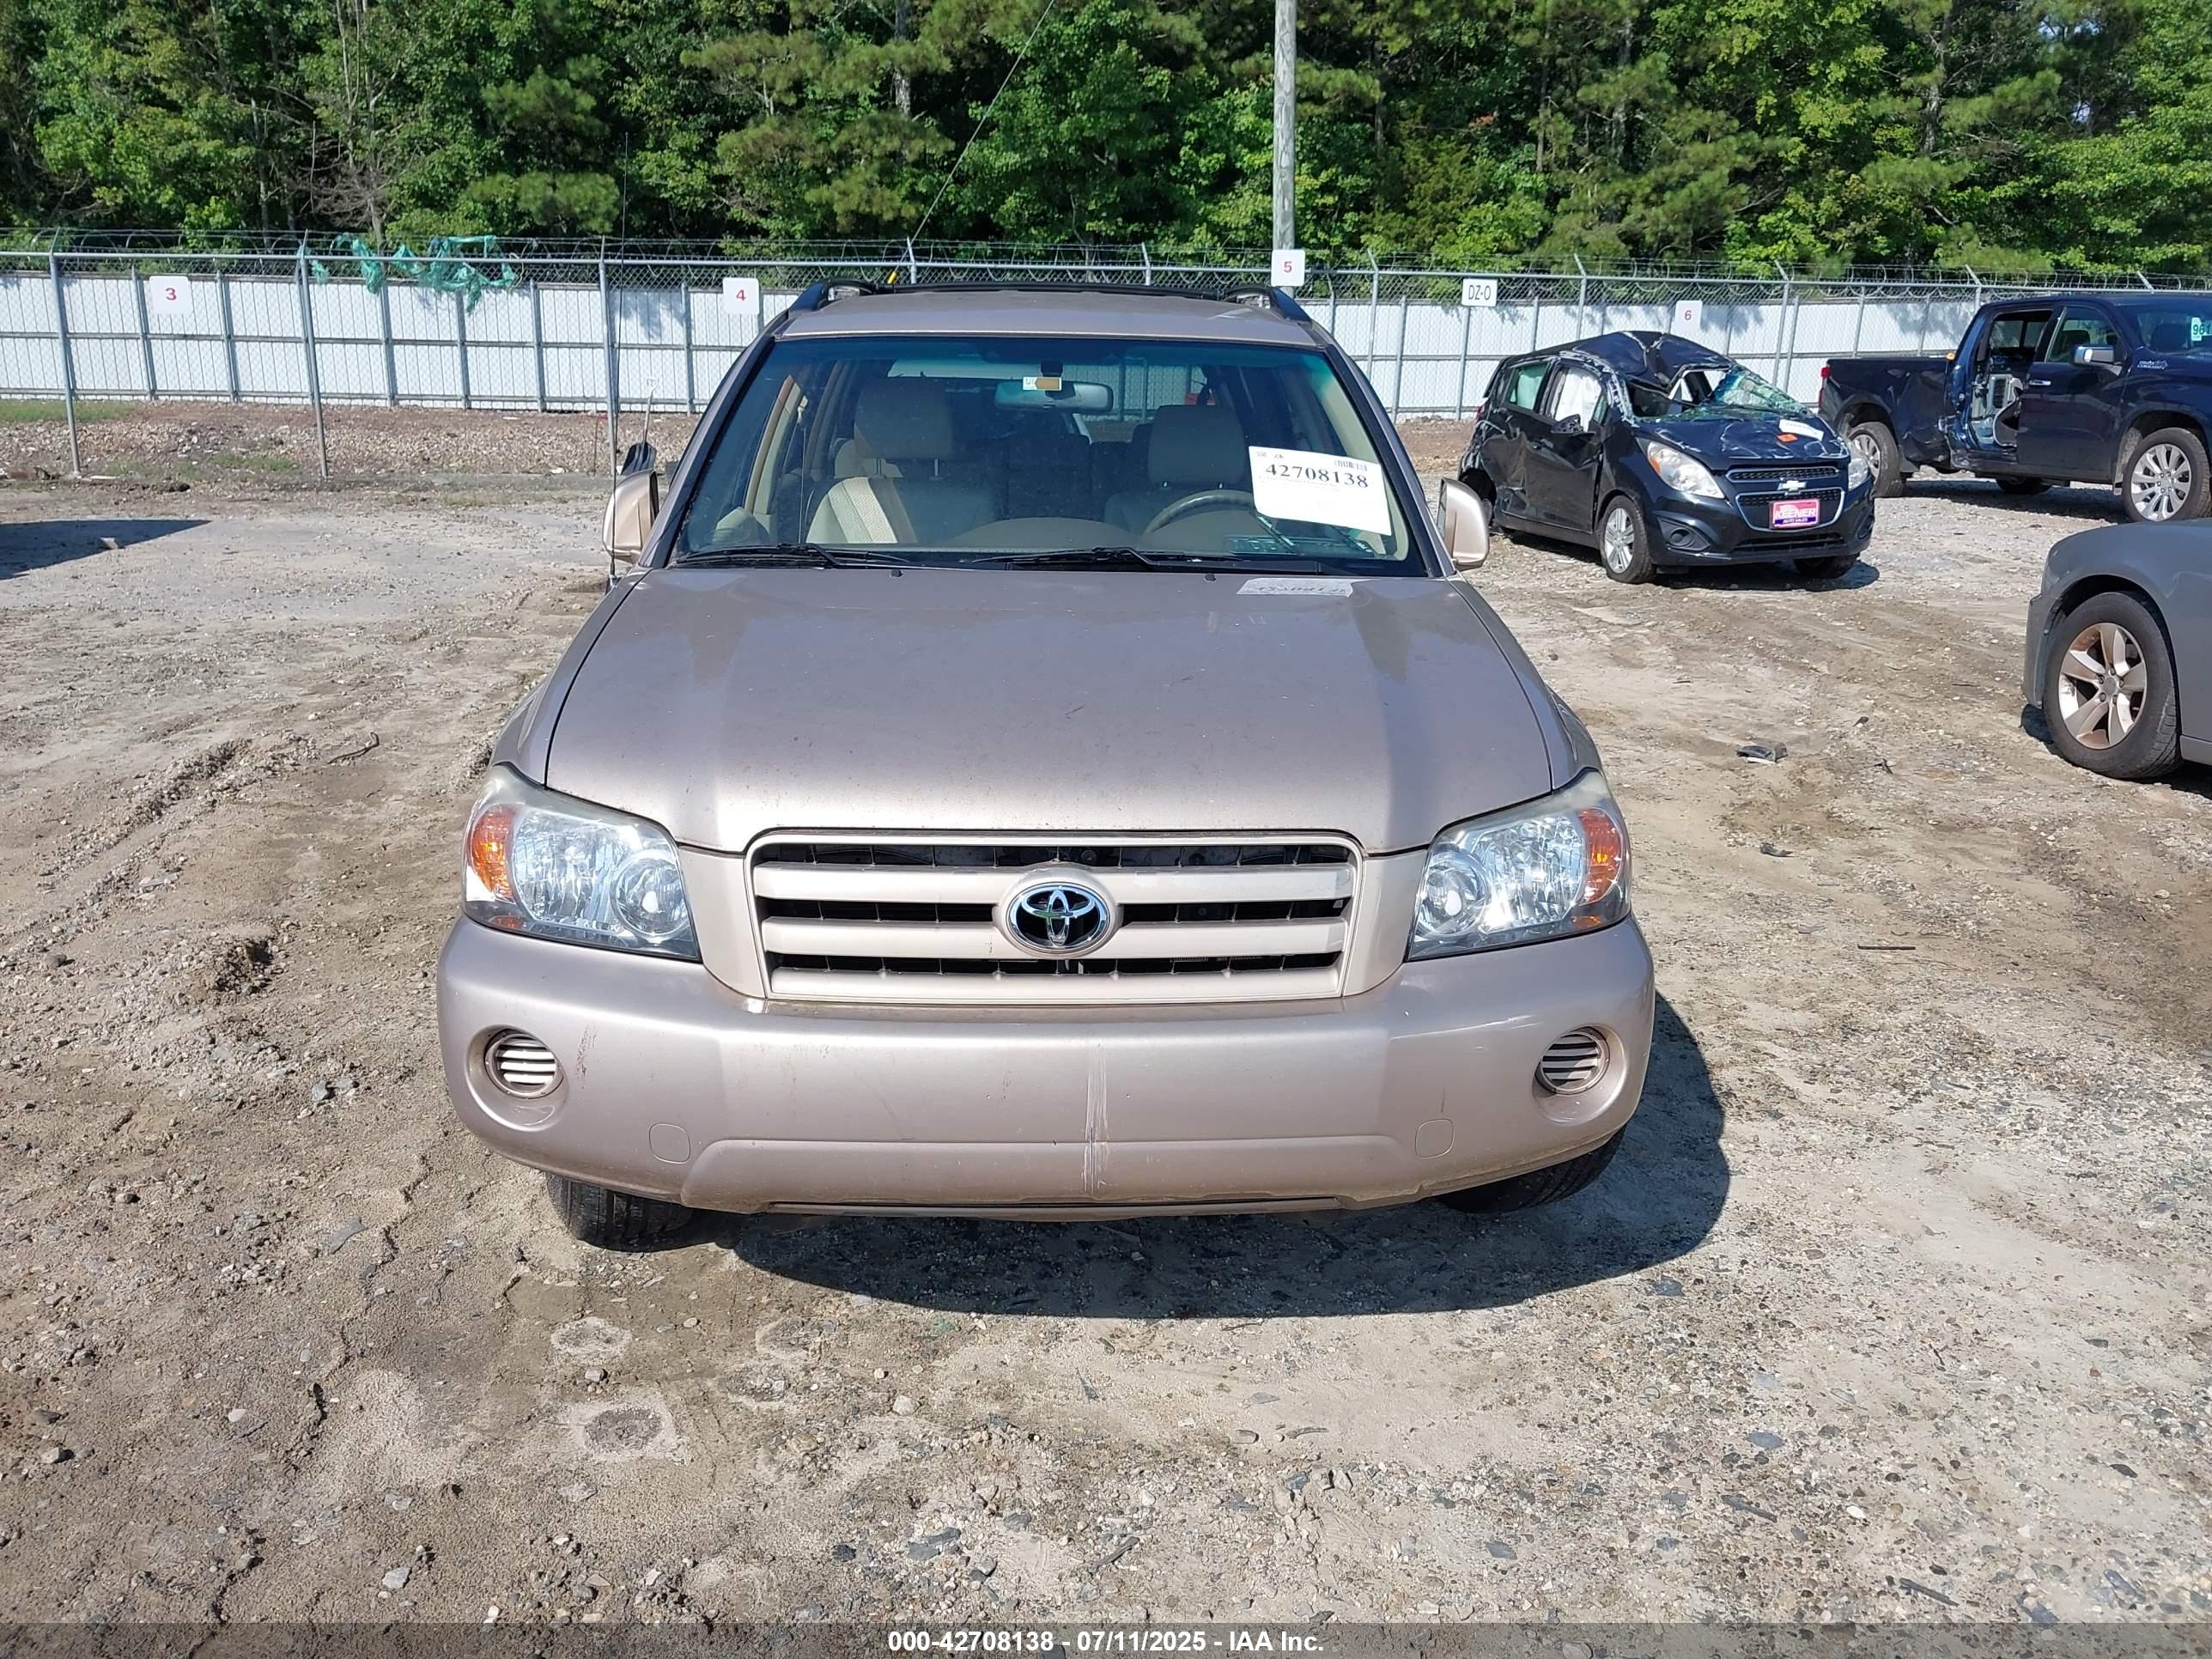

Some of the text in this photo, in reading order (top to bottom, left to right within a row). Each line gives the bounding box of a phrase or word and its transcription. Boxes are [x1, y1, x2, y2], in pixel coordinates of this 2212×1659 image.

[1284, 261, 1292, 273] 5
[165, 288, 177, 301] 3
[736, 289, 747, 301] 4
[1684, 309, 1692, 321] 6
[1266, 464, 1369, 488] 42708138
[1775, 507, 1816, 519] KEENER
